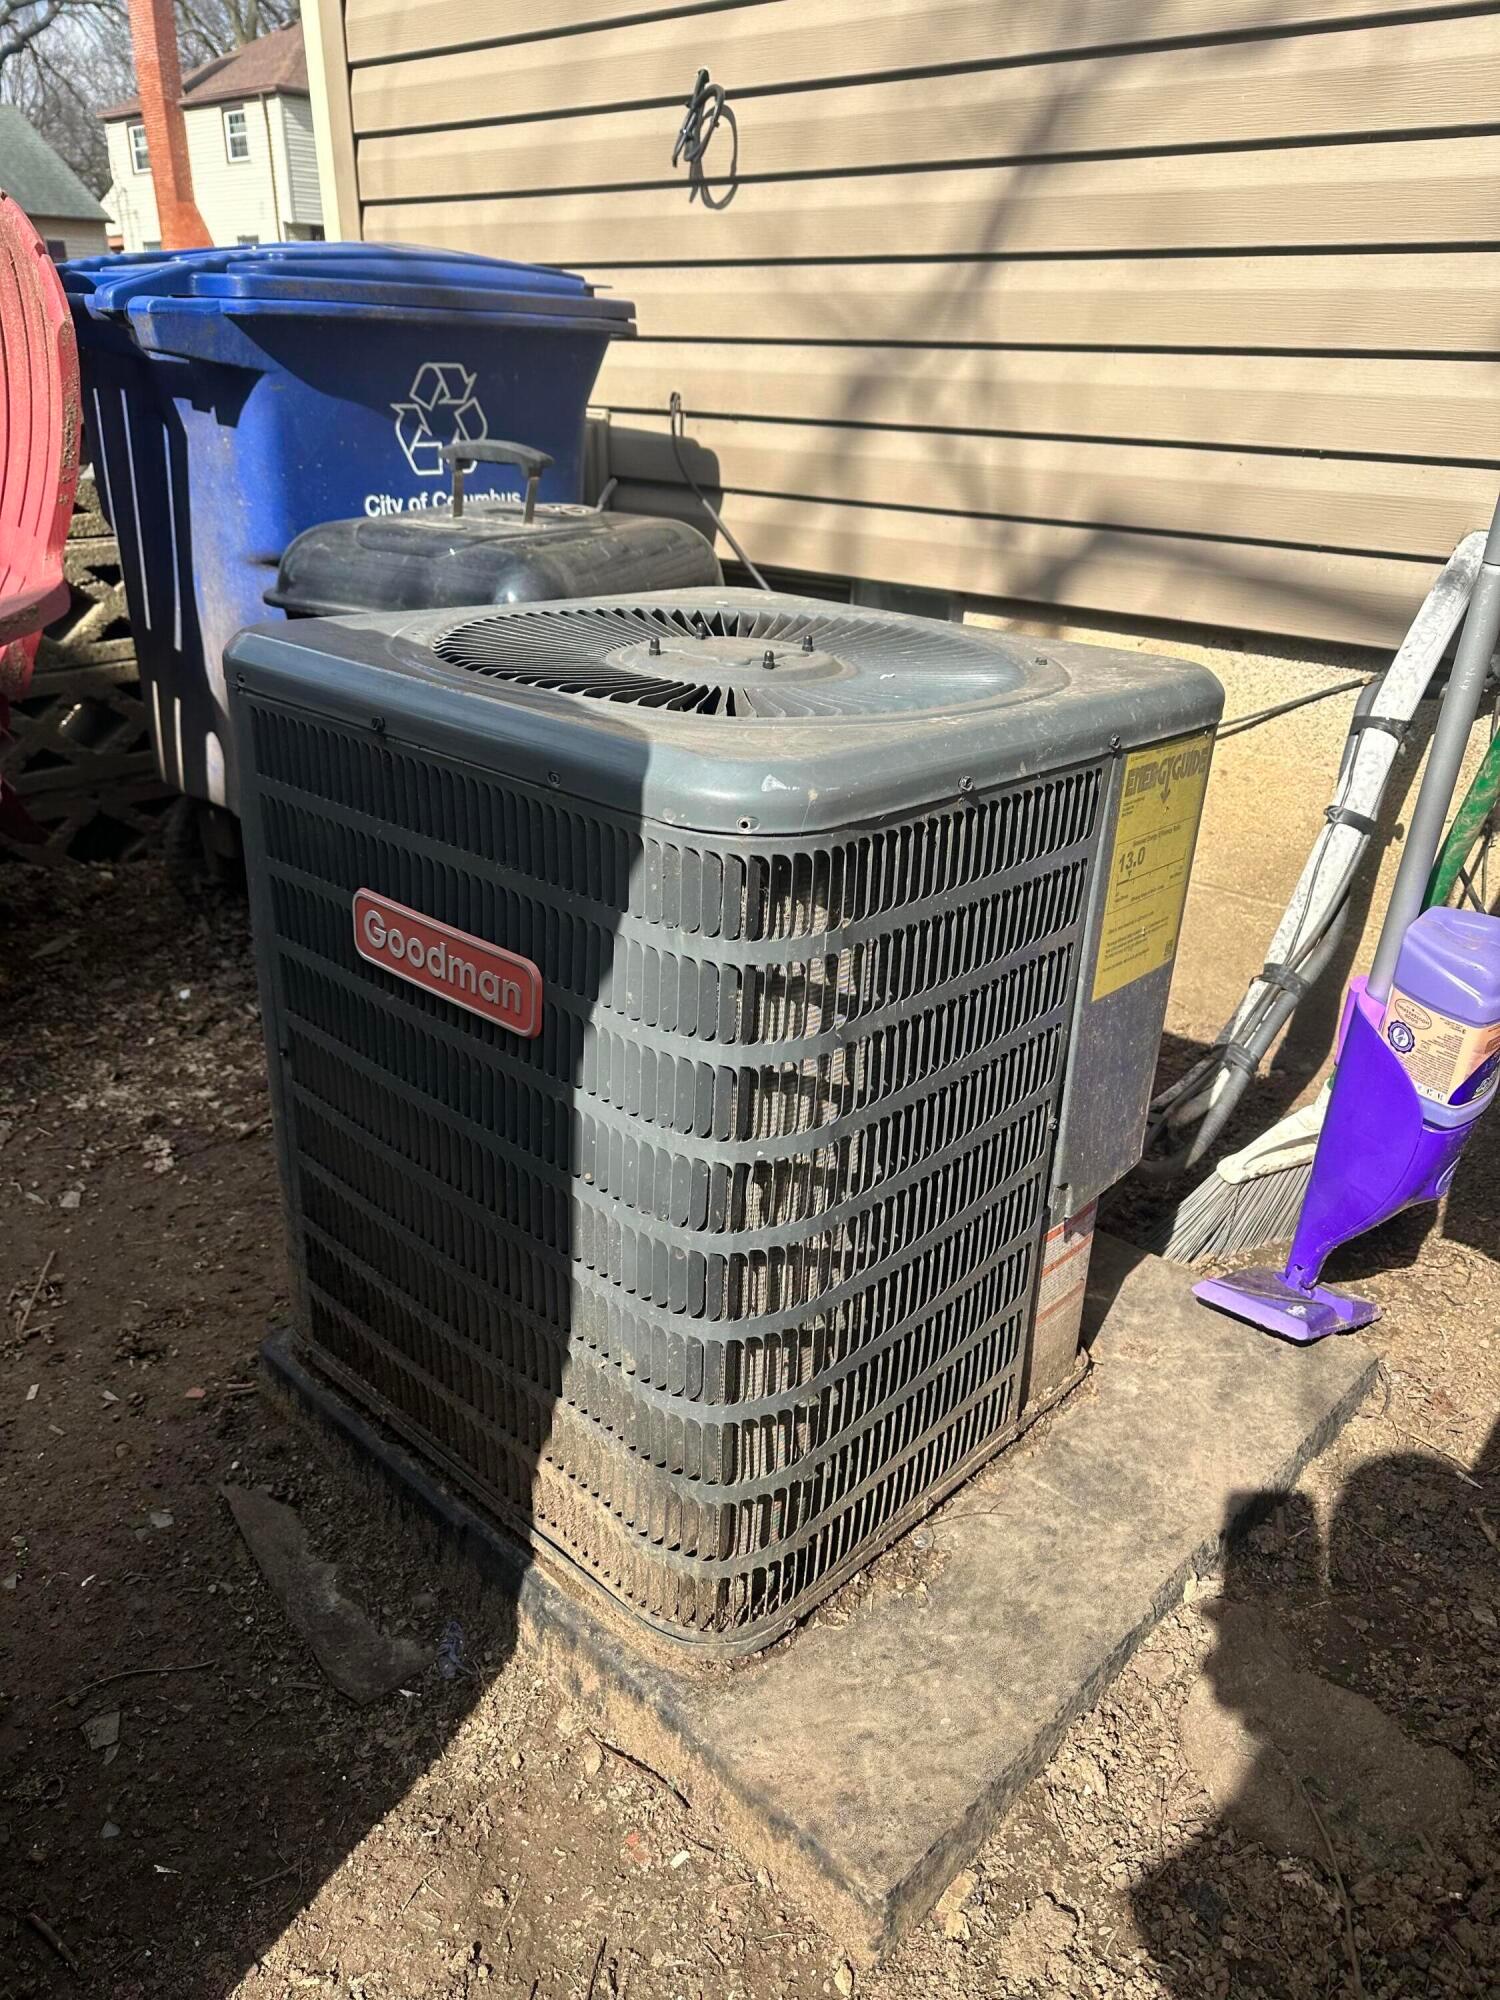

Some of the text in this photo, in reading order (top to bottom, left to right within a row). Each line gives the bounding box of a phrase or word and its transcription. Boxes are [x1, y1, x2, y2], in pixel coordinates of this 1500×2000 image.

[364, 494, 404, 517] City
[408, 491, 428, 511] of
[1118, 846, 1146, 873] 13.0
[364, 909, 522, 1014] Goodman
